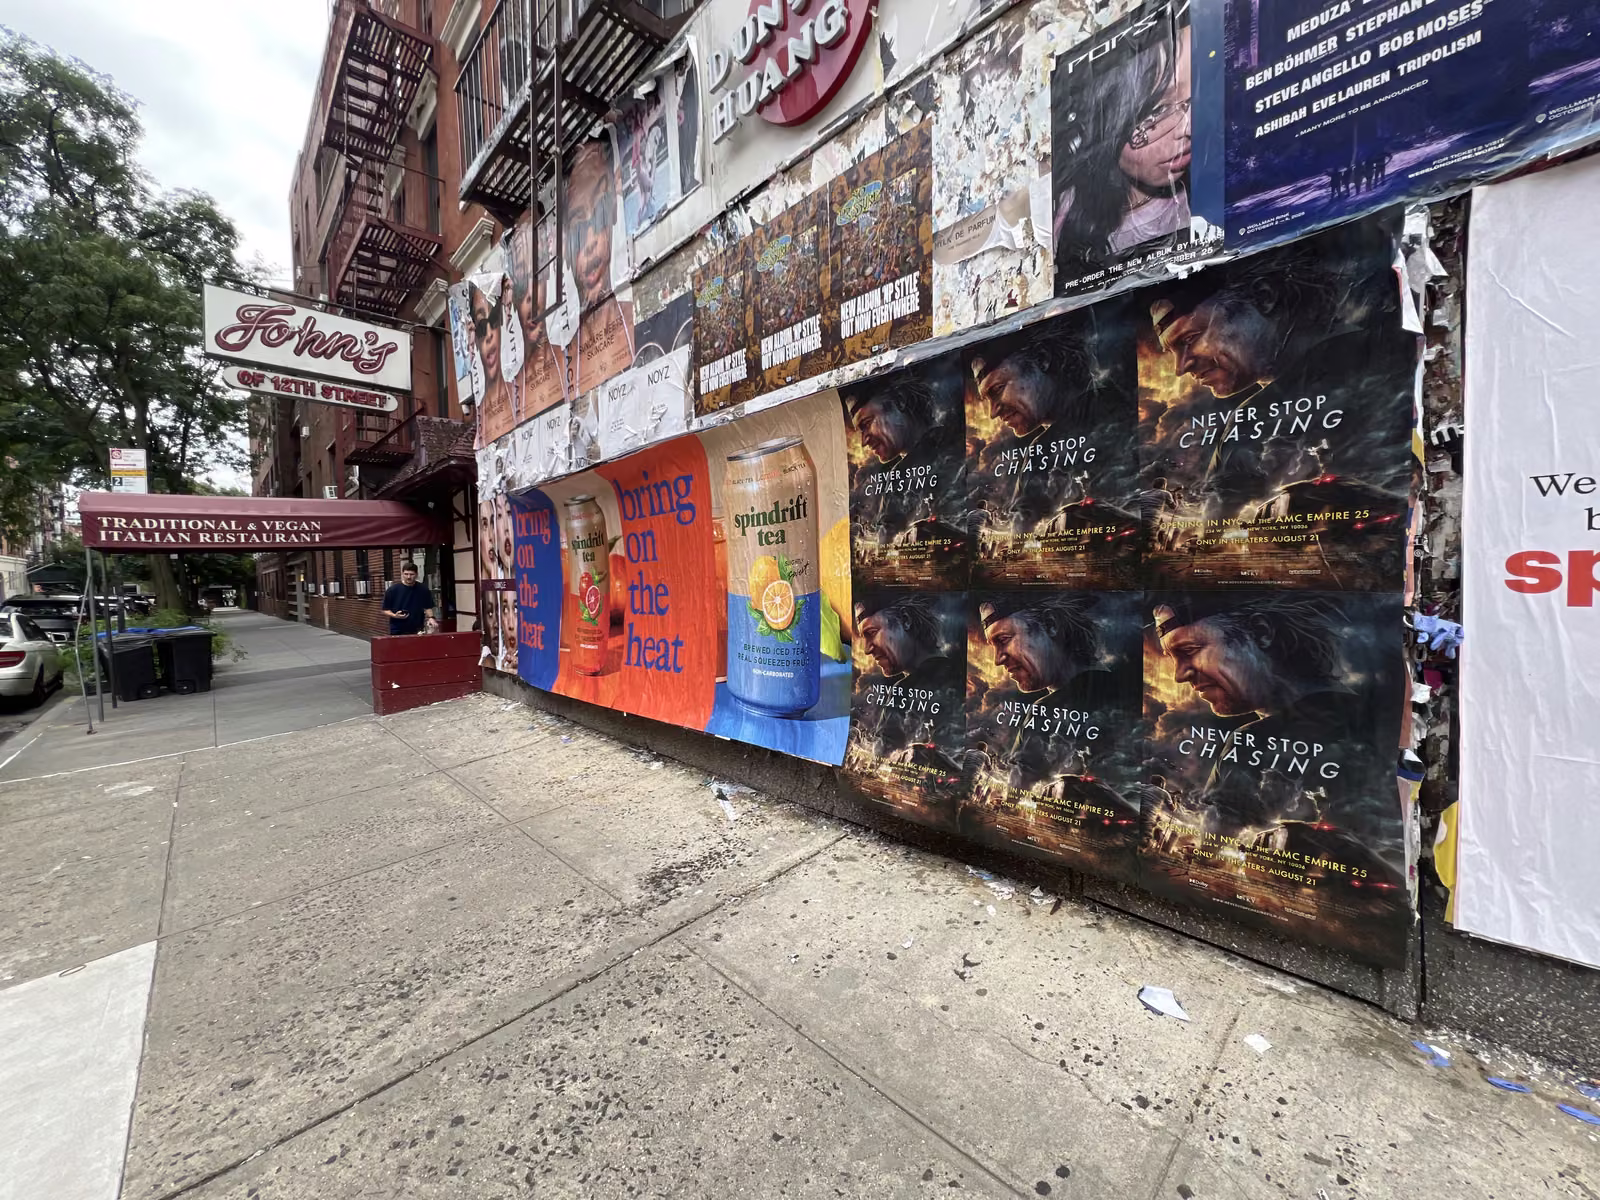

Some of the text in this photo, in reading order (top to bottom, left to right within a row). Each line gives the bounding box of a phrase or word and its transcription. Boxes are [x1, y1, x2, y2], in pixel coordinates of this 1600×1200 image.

[1287, 0, 1351, 43] MEDUZA
[1245, 68, 1273, 91] BEN
[1274, 36, 1338, 77] BÖHMER
[1346, 0, 1422, 42] STEPHAN
[1255, 82, 1300, 114] STEVE
[1301, 50, 1371, 93] ANGELLO
[1379, 30, 1414, 58] BOB
[1417, 0, 1483, 41] MOSES
[711, 0, 848, 144] HUANG
[1255, 30, 1482, 138] ASHIBAH EVE LAUREN TRIPOLISM
[1300, 78, 1429, 136] MANY MORE TO BE ANNOUNCED
[955, 231, 964, 240] DE
[1201, 246, 1214, 256] 25
[1065, 270, 1105, 290] PRE-ORDER
[1108, 263, 1124, 274] THE
[1127, 257, 1143, 268] NEW
[1146, 246, 1173, 262] ALBUM
[1177, 241, 1189, 251] BY
[840, 298, 857, 322] NEW
[857, 287, 881, 316] ALBUM
[841, 317, 855, 339] OUT
[855, 310, 871, 334] NOW
[872, 291, 920, 328] EVERYWHERE
[214, 304, 398, 375] John's
[237, 370, 388, 408] OF 12TH STREET
[647, 365, 670, 387] NOYZ
[608, 383, 627, 402] NOYZ
[1192, 395, 1327, 430] NEVER STOP
[1179, 410, 1344, 448] CHASING
[994, 447, 1096, 477] CHASING
[1001, 436, 1086, 462] NEVER STOP
[865, 474, 938, 496] CHASING
[870, 465, 932, 483] NEVER STOP
[1529, 472, 1597, 497] We
[613, 470, 696, 526] bring
[98, 517, 321, 531] TRADITIONAL & VEGAN
[513, 504, 551, 545] bring
[734, 494, 808, 536] spindrift
[1160, 521, 1203, 530] OPENING
[1223, 518, 1243, 526] NYC
[1275, 514, 1303, 523] AMC
[1307, 511, 1350, 521] EMPIRE
[1355, 510, 1370, 519] 25
[99, 530, 323, 543] ITALIAN RESTAURANT
[626, 528, 658, 564] on
[757, 529, 786, 546] tea
[1058, 529, 1074, 537] AMC
[1077, 527, 1103, 535] EMPIRE
[1231, 536, 1268, 544] THEATERS
[1271, 535, 1307, 543] AUGUST
[517, 543, 535, 568] on
[519, 573, 539, 608] the
[627, 570, 669, 616] the
[519, 612, 545, 650] heat
[624, 622, 684, 673] heat
[738, 653, 752, 663] REAL
[753, 656, 790, 667] SQUEEZED
[743, 643, 805, 656] BREWED ICED TEA
[866, 693, 941, 715] CHASING
[872, 684, 934, 700] NEVER STOP
[996, 712, 1100, 740] CHASING
[1003, 700, 1089, 723] NEVER STOP
[1191, 726, 1324, 757] NEVER STOP
[1178, 740, 1341, 779] CHASING
[1050, 814, 1073, 824] AUGUST
[1053, 798, 1071, 807] AMC
[1074, 802, 1101, 815] EMPIRE
[1104, 809, 1114, 818] 25
[1157, 821, 1200, 836] OPENING
[1205, 832, 1217, 840] IN
[1220, 835, 1241, 846] NYC
[1273, 848, 1300, 861] AMC
[1304, 855, 1347, 873] EMPIRE
[1352, 867, 1368, 878] 25
[1193, 848, 1214, 858] ONLY
[1228, 859, 1265, 872] THEATERS
[1268, 867, 1304, 882] AUGUST
[1306, 877, 1316, 885] 21
